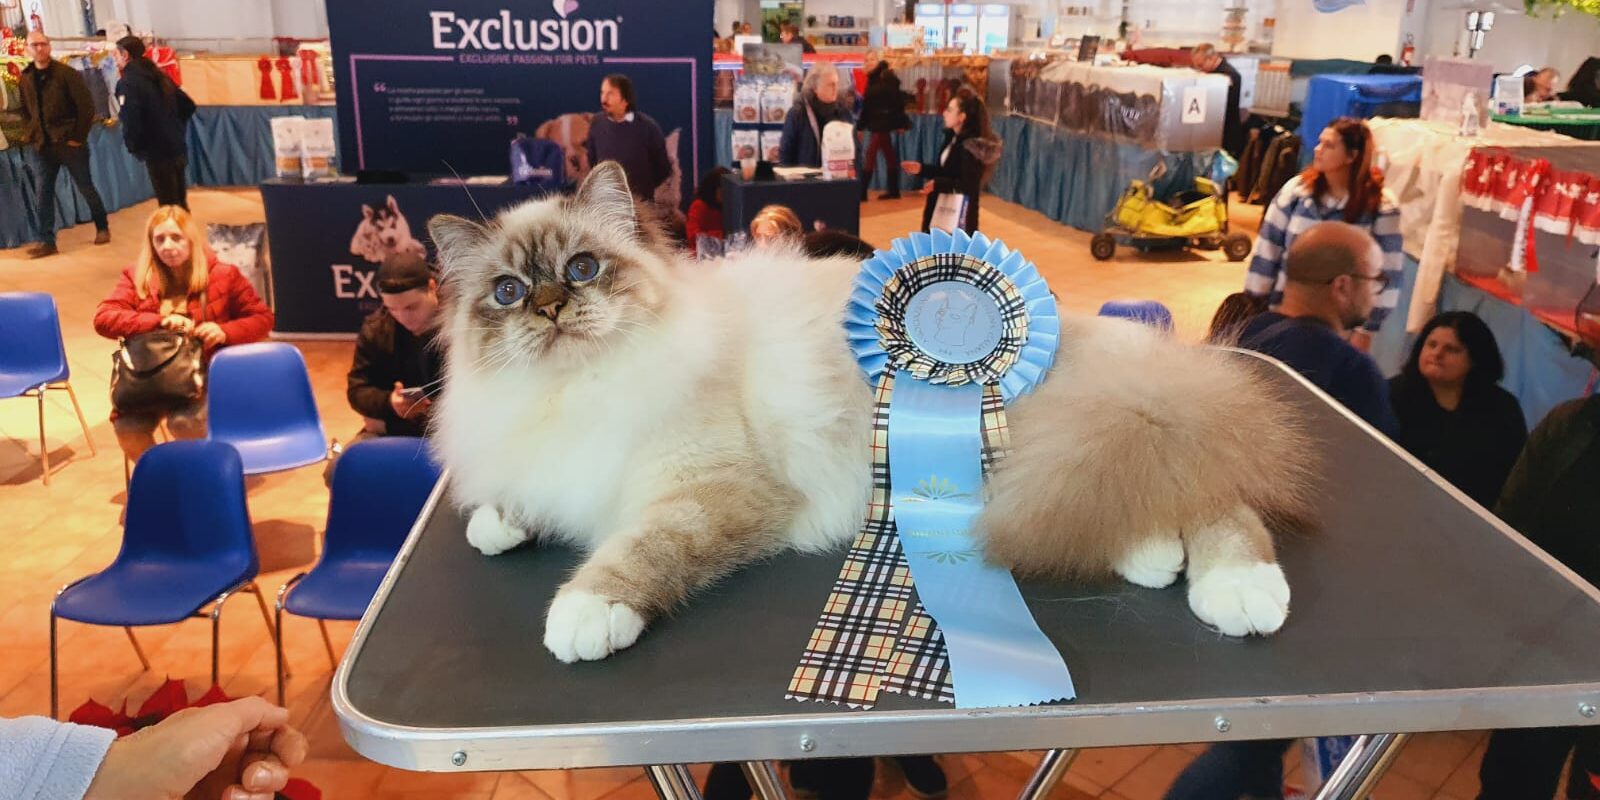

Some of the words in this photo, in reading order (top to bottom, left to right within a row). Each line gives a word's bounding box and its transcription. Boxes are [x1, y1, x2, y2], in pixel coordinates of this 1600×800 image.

[430, 10, 618, 51] Exclusion
[459, 53, 511, 64] EXCLUSIVE
[513, 54, 553, 64] PASSION
[555, 54, 574, 64] FOR
[575, 54, 598, 65] PETS
[1188, 98, 1200, 114] A
[331, 264, 380, 299] Ex
